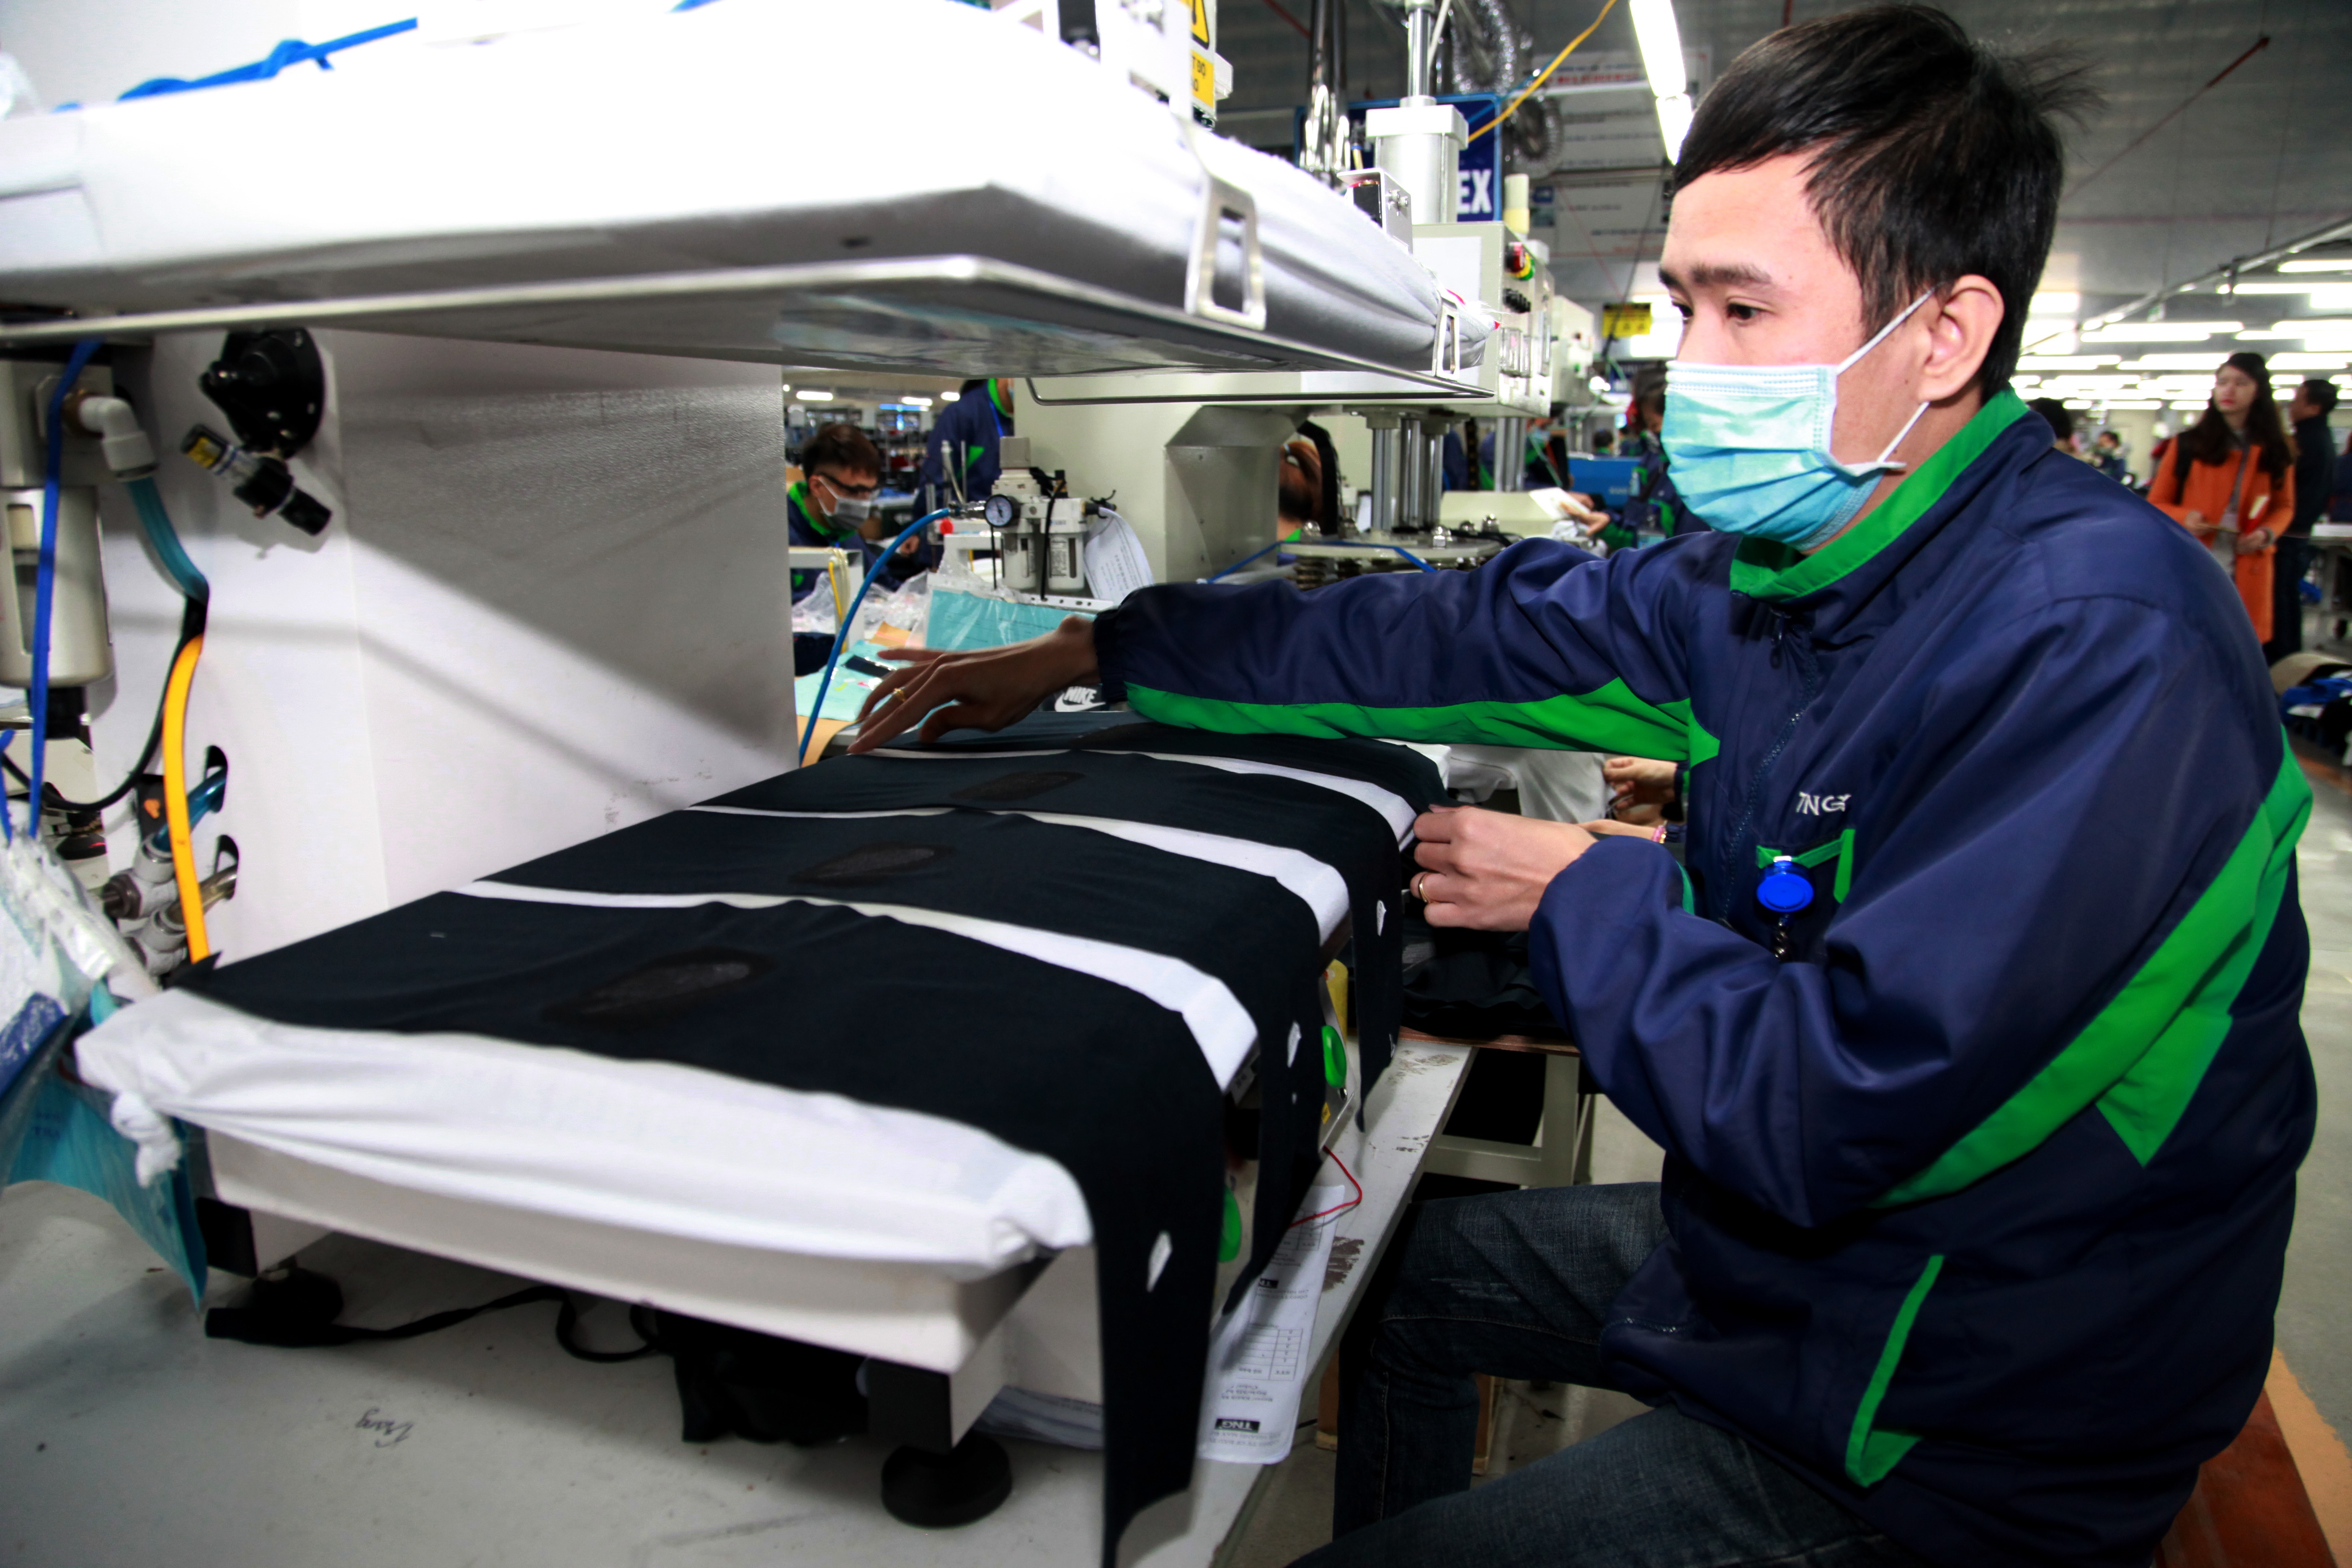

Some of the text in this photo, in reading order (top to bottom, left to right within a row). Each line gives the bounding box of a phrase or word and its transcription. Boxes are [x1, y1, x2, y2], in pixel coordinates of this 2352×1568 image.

[1457, 169, 1492, 214] EX
[1064, 686, 1097, 704] NIKE
[1220, 1421, 1253, 1430] TNG
